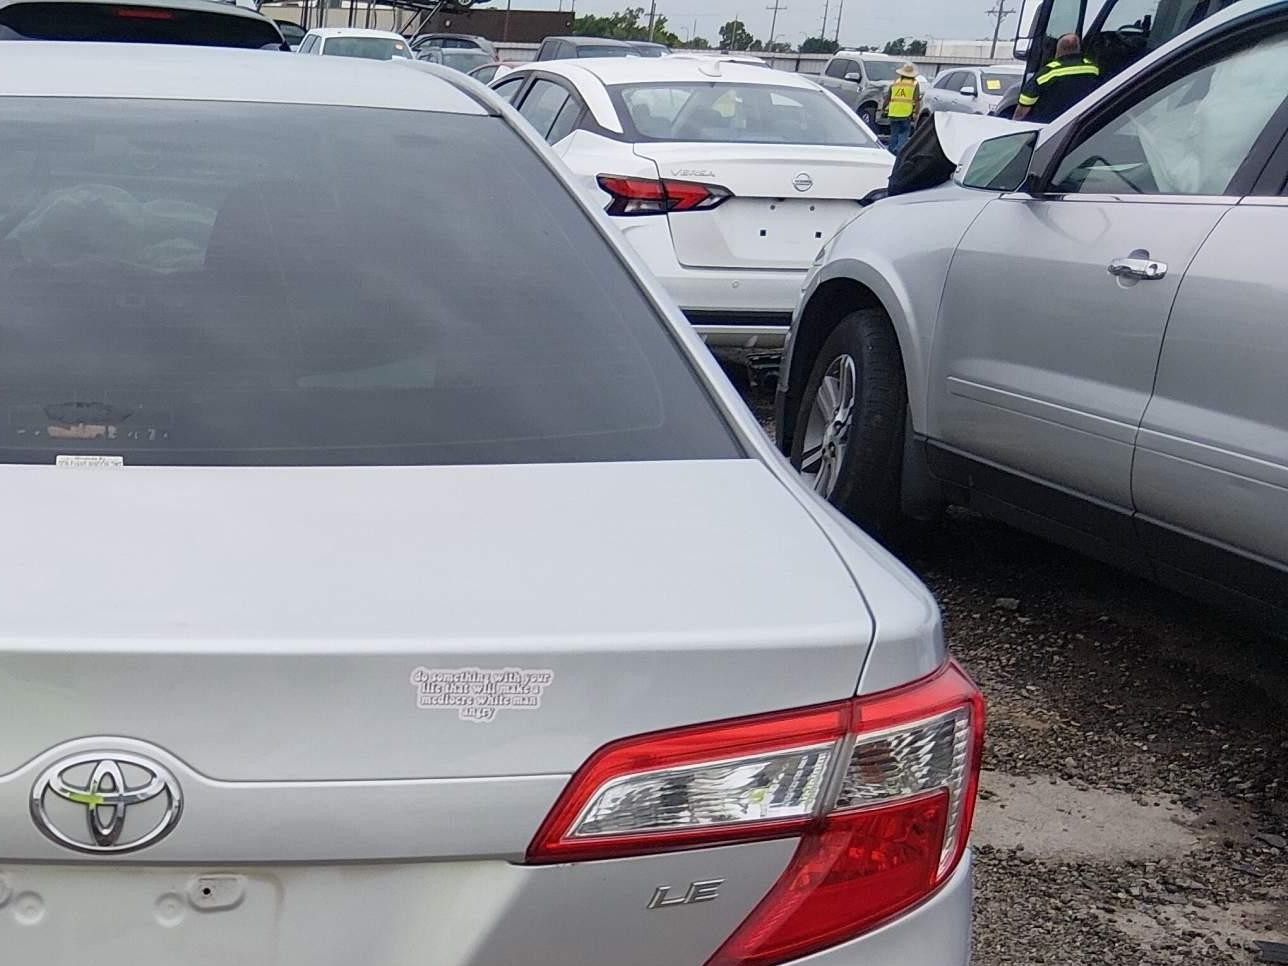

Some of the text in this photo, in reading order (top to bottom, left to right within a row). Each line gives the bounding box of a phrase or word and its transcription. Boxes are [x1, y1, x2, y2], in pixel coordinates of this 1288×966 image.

[670, 169, 715, 178] VERSA
[414, 671, 552, 686] do something with your
[422, 682, 540, 694] life that will make a
[421, 694, 538, 706] mediocre white man
[647, 879, 725, 909] LE
